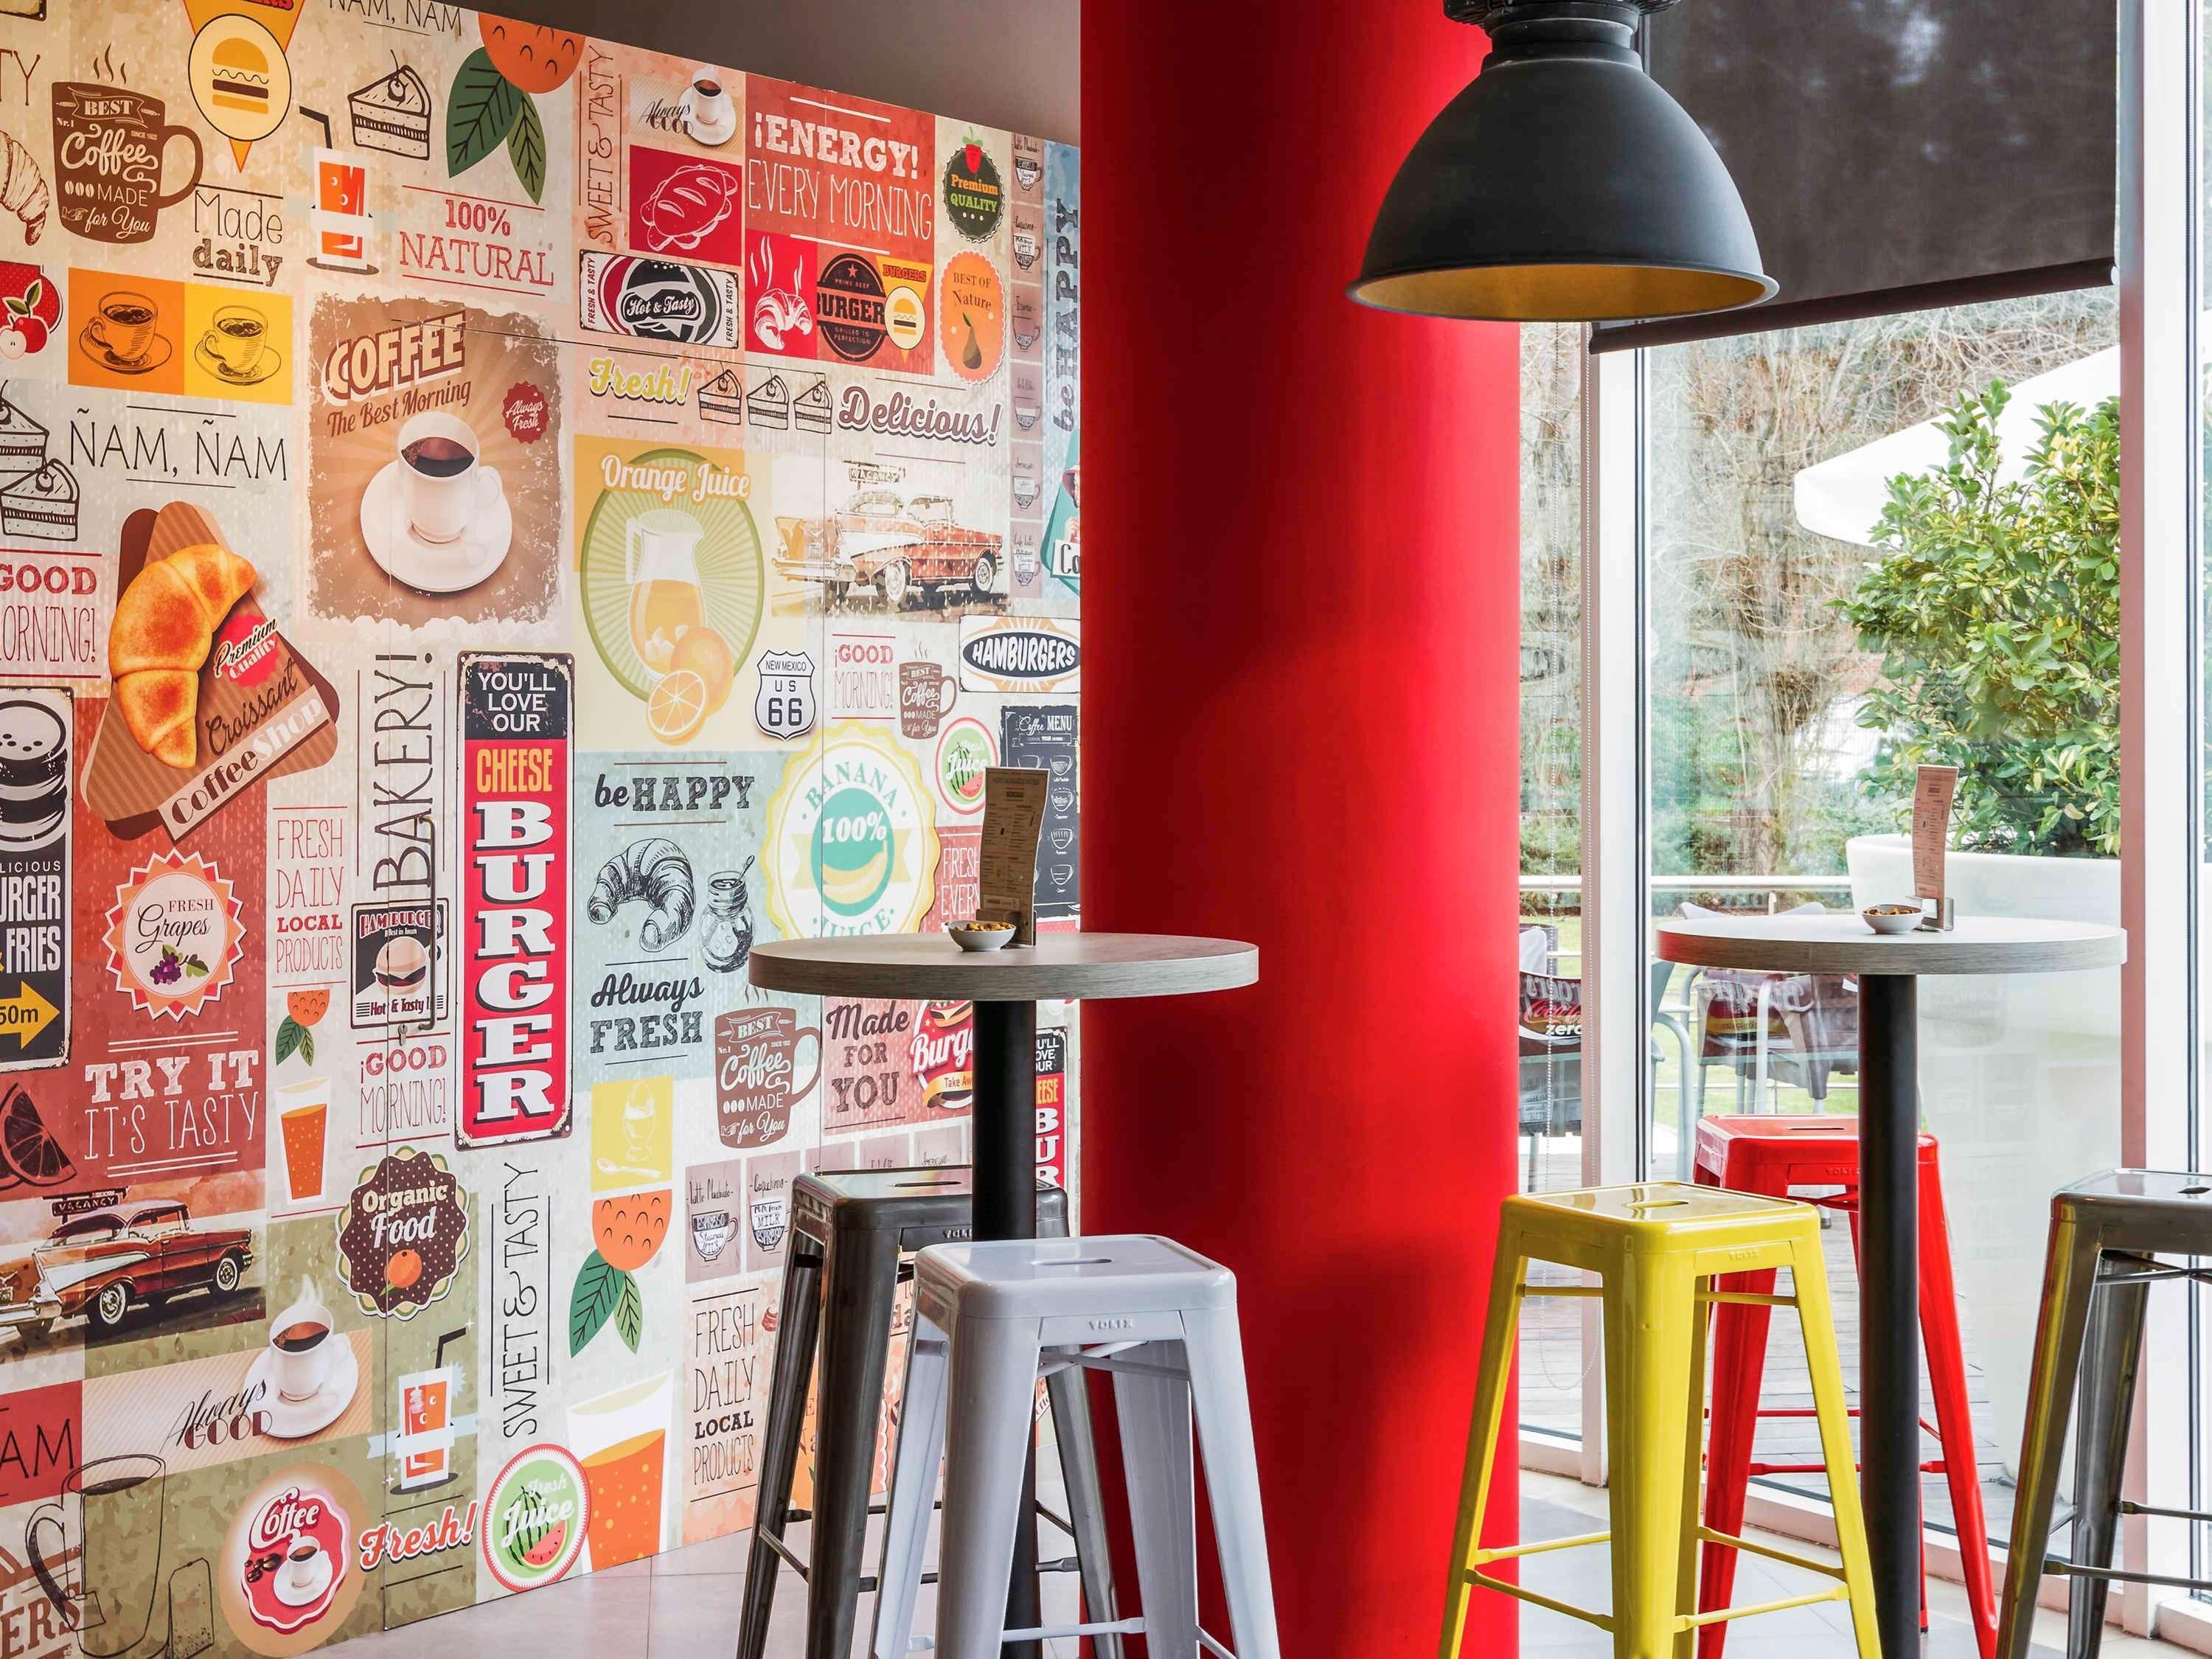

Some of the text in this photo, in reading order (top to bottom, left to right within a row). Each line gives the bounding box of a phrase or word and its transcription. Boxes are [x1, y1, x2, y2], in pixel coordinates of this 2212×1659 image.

[84, 100, 133, 116] BEST
[637, 98, 692, 124] Always
[650, 115, 694, 135] GOOD
[61, 124, 159, 186] Coffee
[588, 46, 613, 244] SWEET & TASTY
[755, 112, 918, 180] ¡ENERGY!
[97, 184, 148, 207] MADE
[748, 159, 932, 240] EVERY MORNING
[950, 174, 998, 195] Premium
[950, 194, 998, 212] QUALITY
[85, 206, 150, 239] for You
[195, 189, 283, 244] Made
[445, 198, 511, 237] 100%
[192, 238, 283, 287] daily
[399, 231, 554, 286] NATURAL
[883, 264, 927, 283] BURGERS
[953, 272, 992, 288] BEST OF
[588, 297, 596, 324] FRESH
[627, 296, 696, 317] Hot & Tasty
[952, 290, 992, 310] Nature
[324, 310, 467, 402] COFFEE
[834, 334, 872, 344] PERFECTION
[590, 358, 692, 406] Fresh!
[327, 380, 472, 437] The Best Morning
[505, 399, 544, 421] Always
[512, 415, 540, 431] Fresh
[838, 386, 1002, 446] Delicious!
[70, 407, 288, 481] ÑAM, ÑAM
[601, 455, 751, 502] Orange Juice
[0, 605, 96, 663] ORNING!
[215, 616, 278, 678] Premium
[229, 638, 277, 681] Quality
[765, 660, 807, 672] NEW MEXICO
[834, 644, 894, 667] ¡GOOD
[911, 667, 931, 678] BEST
[972, 636, 1076, 672] HAMBURGERS
[478, 672, 556, 692] YOU'LL
[833, 671, 894, 709] MORNING!
[902, 681, 940, 708] Coffee
[205, 657, 300, 757] Croissant
[488, 693, 546, 712] LOVE
[768, 698, 803, 726] 66
[916, 710, 936, 720] MADE
[493, 714, 540, 732] OUR
[1019, 715, 1072, 736] Coffee MENU
[373, 653, 433, 891] BAKERY!
[476, 748, 553, 793] CHEESE
[804, 761, 897, 810] BANANA
[946, 754, 989, 779] Juice
[276, 818, 344, 860] FRESH
[822, 811, 887, 844] 100%
[168, 898, 215, 912] FRESH
[276, 866, 345, 909] DAILY
[134, 904, 212, 954] Grapes
[276, 914, 344, 933] LOCAL
[7, 926, 60, 973] FRIES
[276, 936, 344, 973] PRODUCTS
[473, 801, 556, 1124] BURGER
[370, 998, 424, 1016] Hot & Tasty
[590, 973, 704, 1013] Always
[590, 1011, 703, 1054] FRESH
[737, 1015, 773, 1039] BEST
[826, 1001, 910, 1040] Made
[360, 1045, 447, 1084] ¡GOOD
[720, 1043, 791, 1091] Coffee
[844, 1043, 888, 1068] FOR
[85, 1050, 259, 1103] TRY IT
[831, 1071, 900, 1113] YOU
[945, 1077, 960, 1088] Take
[360, 1077, 447, 1135] MORNING!
[746, 1092, 784, 1112] MADE
[84, 1091, 259, 1160] IT'S TASTY
[737, 1111, 785, 1144] for You
[58, 1196, 116, 1211] VACANCY
[361, 1180, 449, 1219] Organic
[371, 1206, 438, 1249] Food
[502, 1162, 539, 1438] SWEET & TASTY
[695, 1303, 755, 1357] FRESH
[693, 1355, 757, 1413] DAILY
[160, 1380, 268, 1453] Always
[184, 1410, 273, 1450] GOOD
[695, 1411, 754, 1440] LOCAL
[693, 1434, 755, 1486] PRODUCTS
[526, 1474, 568, 1498] Fresh
[249, 1486, 320, 1548] Coffee
[359, 1501, 479, 1571] Fresh!
[501, 1498, 575, 1549] Juice
